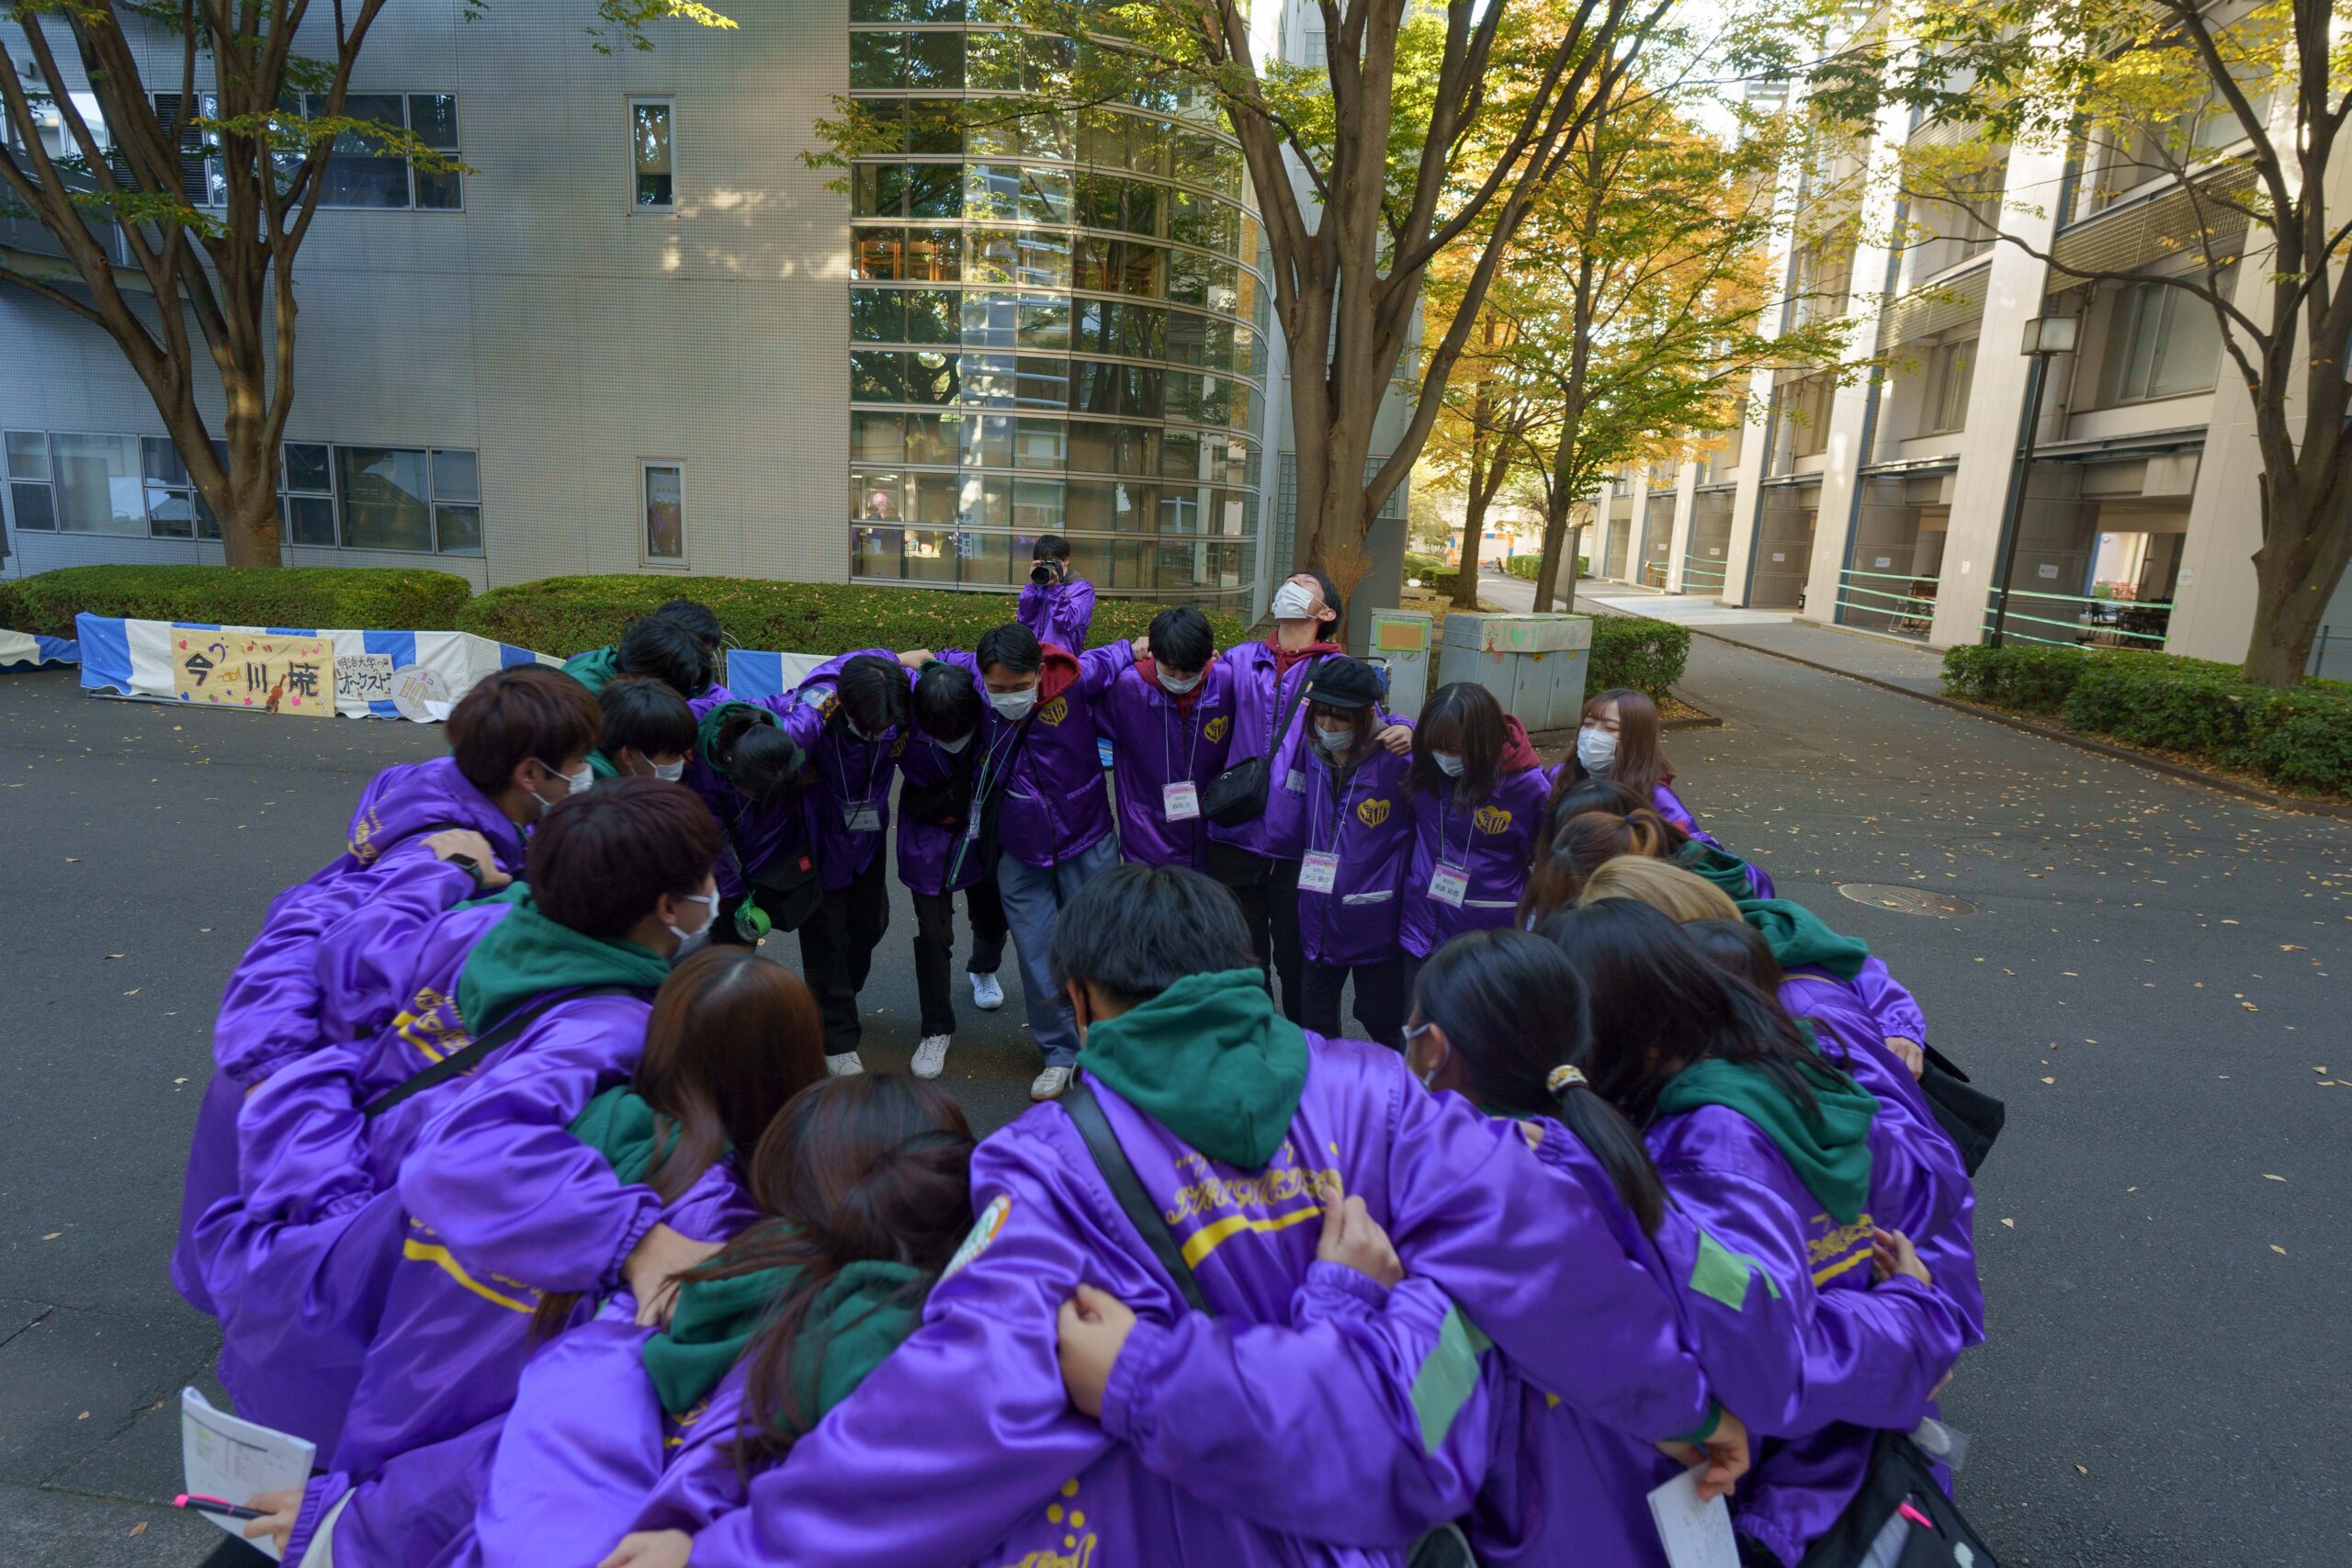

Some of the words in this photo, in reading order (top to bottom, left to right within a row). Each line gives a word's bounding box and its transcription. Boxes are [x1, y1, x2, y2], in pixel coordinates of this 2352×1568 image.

[185, 651, 322, 698] 今川焼
[336, 656, 376, 670] 明治大学
